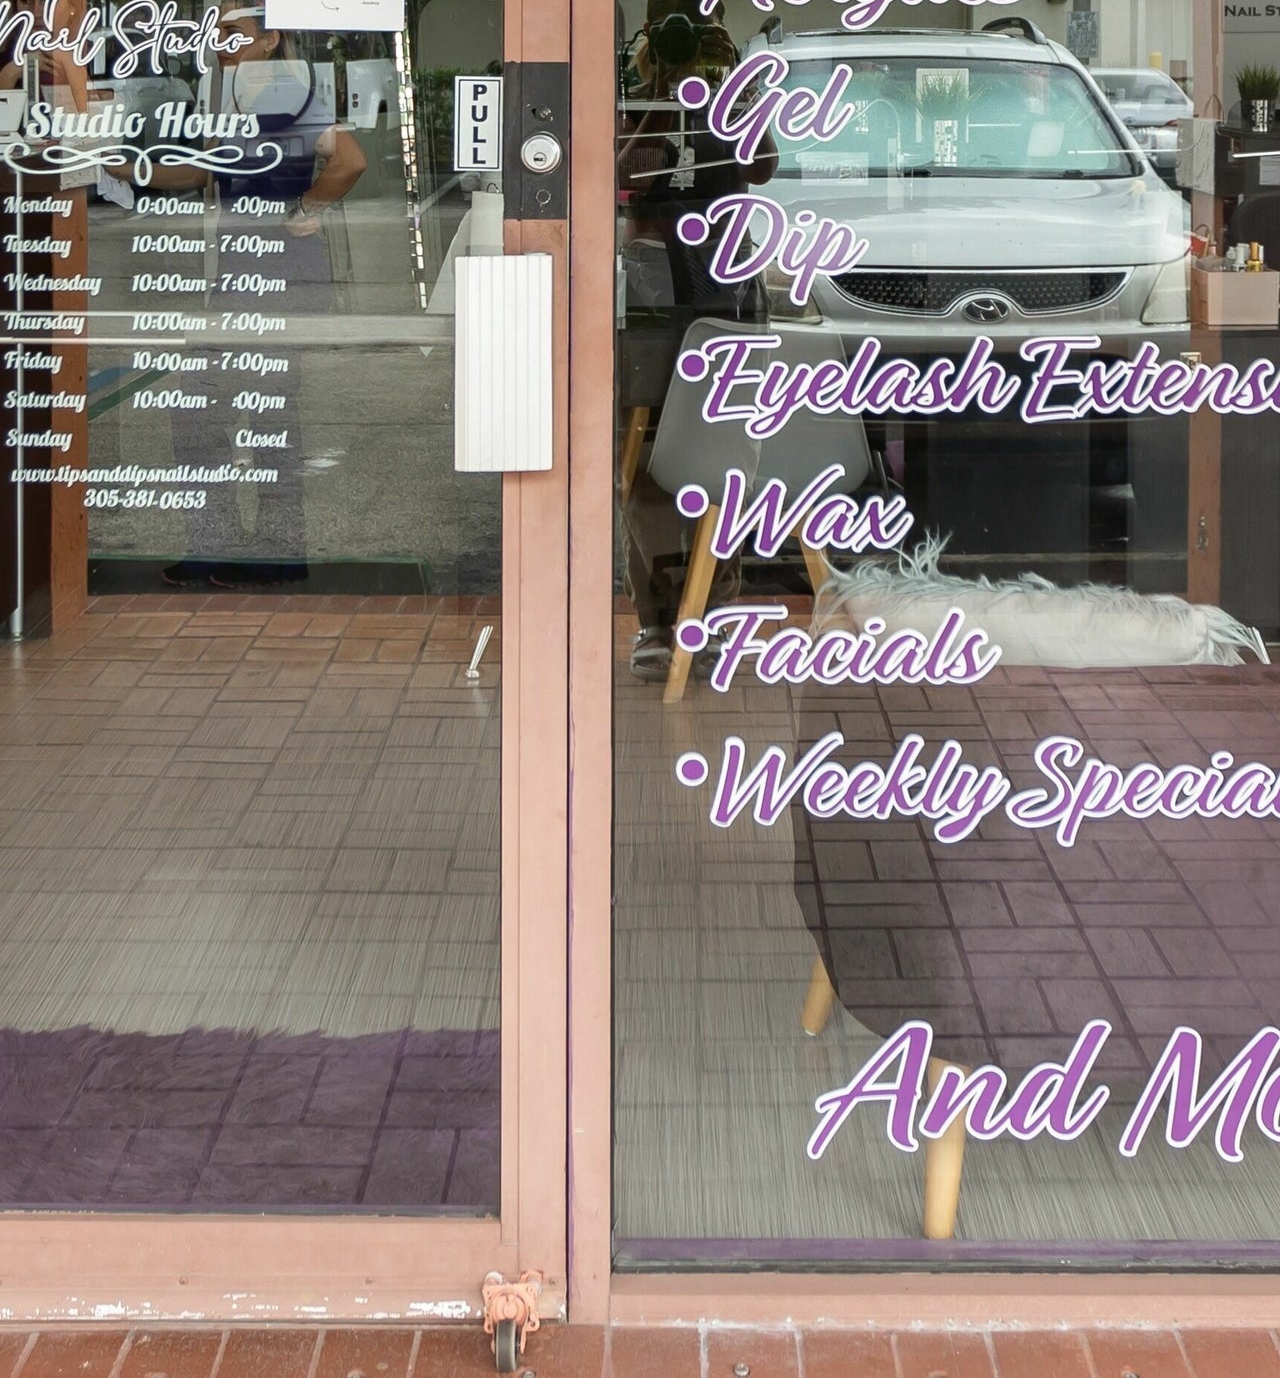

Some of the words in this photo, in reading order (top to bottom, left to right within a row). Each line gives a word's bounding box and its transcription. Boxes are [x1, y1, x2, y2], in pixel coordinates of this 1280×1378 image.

[1223, 5, 1262, 17] NAIL
[708, 50, 856, 164] Gel
[26, 101, 147, 139] Studio
[154, 101, 261, 139] Hours
[471, 84, 488, 164] PULL
[3, 196, 74, 218] Monday
[3, 234, 72, 258] Tuesday
[131, 234, 206, 253] 10:00am
[220, 234, 285, 258] 7:00pm
[706, 193, 870, 306] Dip
[3, 273, 102, 296] Wednesday
[131, 273, 207, 292] 10:00am
[221, 273, 287, 297] 7:00pm
[3, 312, 86, 335] Thursday
[131, 312, 207, 331] 10:00am
[221, 312, 286, 335] 7:00pm
[3, 351, 63, 374] Friday
[132, 351, 208, 371] 10:00am
[221, 351, 289, 376] 7:00pm
[701, 334, 1021, 439] Eyelash
[3, 390, 87, 413] Saturday
[132, 389, 208, 409] 10:00am
[5, 429, 73, 452] Sunday
[235, 429, 289, 448] Closed
[10, 464, 279, 487] www.tipsanddipsnailstudio.com
[83, 488, 207, 509] 305-381-0653
[711, 462, 915, 560] Wax
[705, 603, 1003, 693] Facials
[710, 731, 1010, 844] Weekly
[805, 1019, 1113, 1160] And
